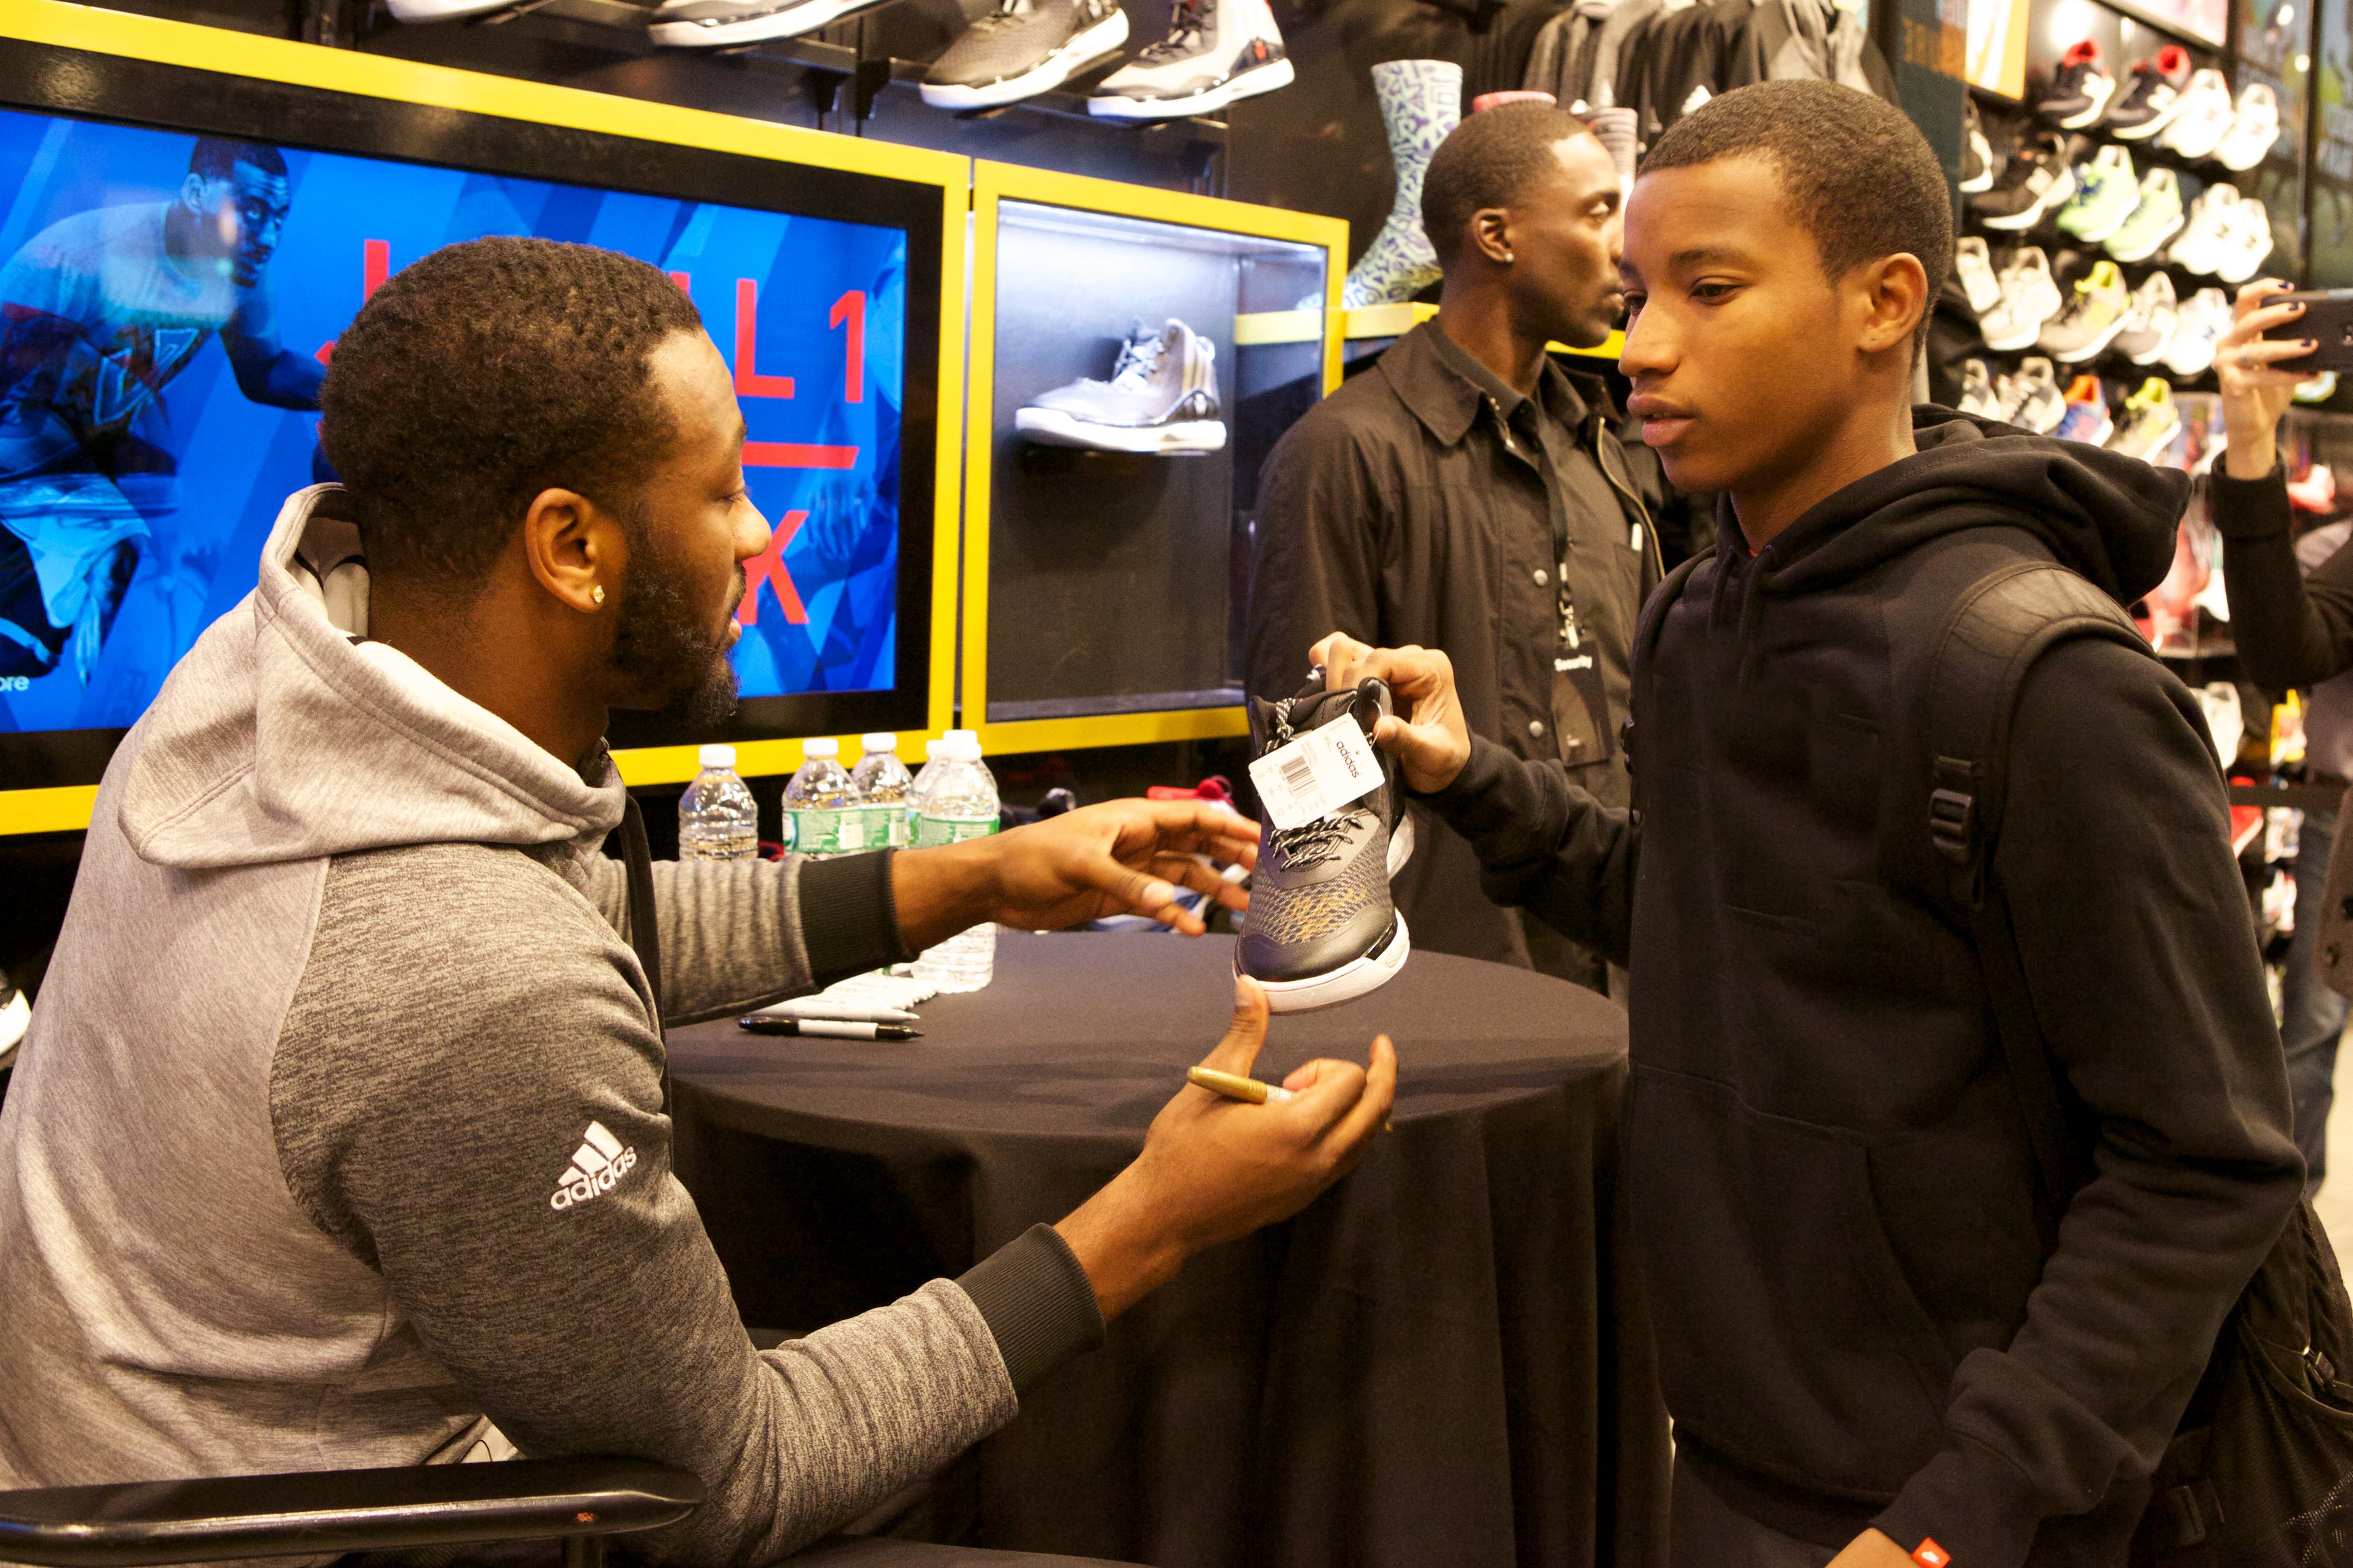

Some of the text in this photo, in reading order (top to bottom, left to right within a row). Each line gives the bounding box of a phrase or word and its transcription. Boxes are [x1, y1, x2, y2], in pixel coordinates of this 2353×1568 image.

[830, 290, 866, 403] 1
[1336, 741, 1359, 778] adidas
[550, 1146, 637, 1211] adidas
